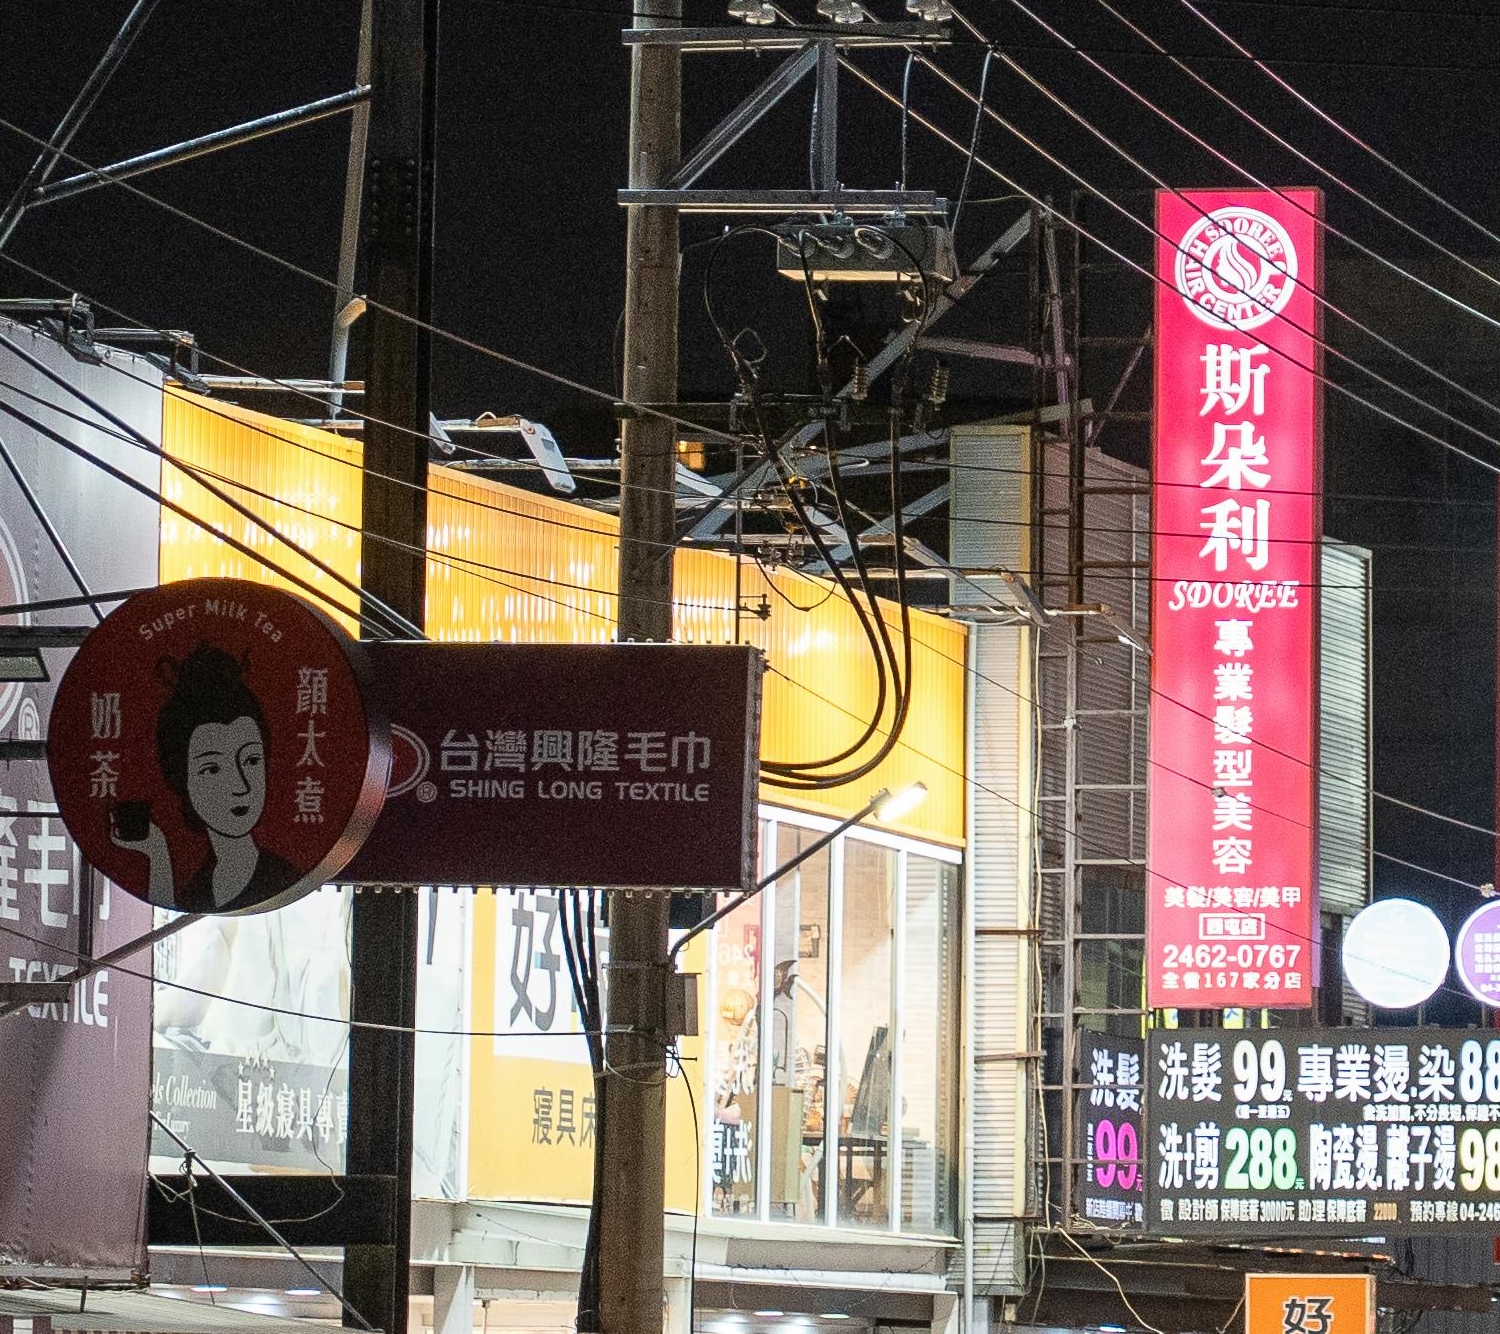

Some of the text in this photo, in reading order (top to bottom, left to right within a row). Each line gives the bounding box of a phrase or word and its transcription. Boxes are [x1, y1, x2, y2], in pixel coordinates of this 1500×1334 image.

[1198, 344, 1272, 571] 斯朵利
[1169, 580, 1300, 611] SDOREE
[138, 597, 286, 644] Super Milk Tea
[88, 692, 122, 799] 奶茶
[440, 729, 712, 774] 台灣興隆毛巾
[1212, 618, 1254, 876] 專業髮型美容
[449, 779, 710, 803] SHING LONG TEXTILE
[1163, 886, 1301, 908] 美髮/美容/美甲
[1162, 944, 1301, 969] 2462-0767
[165, 1075, 217, 1110] Collection
[1158, 1042, 1222, 1102] 洗髮
